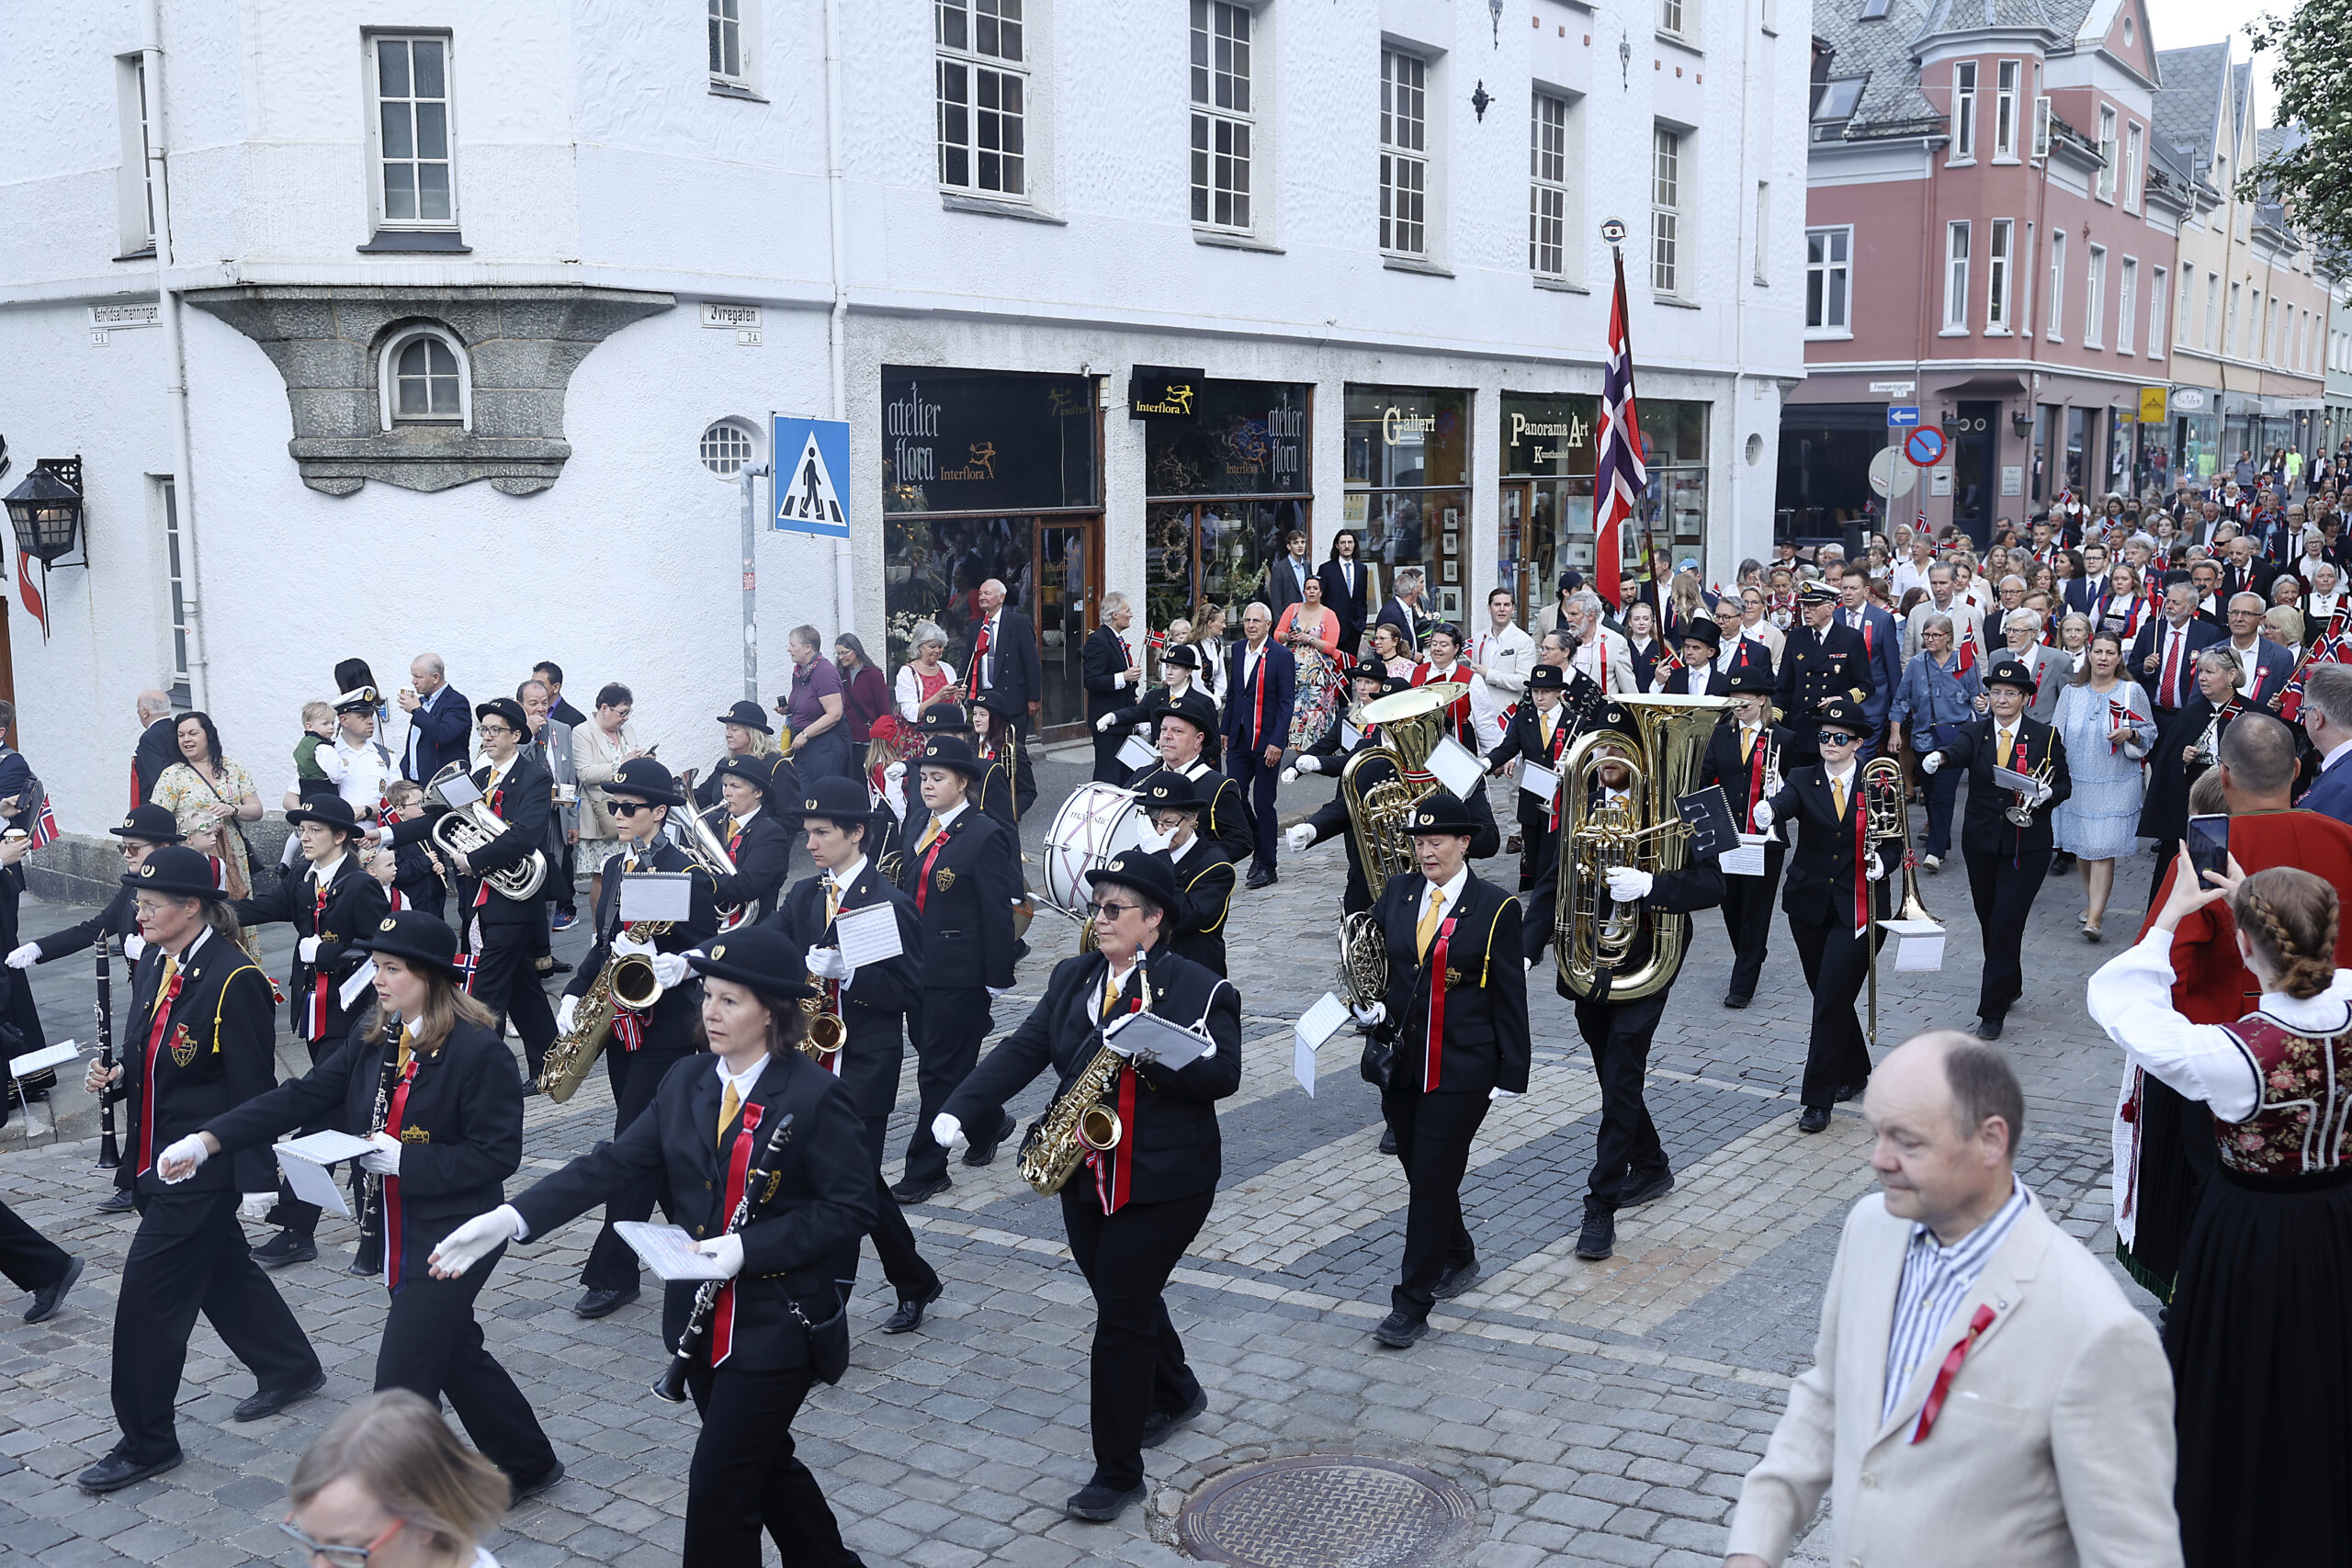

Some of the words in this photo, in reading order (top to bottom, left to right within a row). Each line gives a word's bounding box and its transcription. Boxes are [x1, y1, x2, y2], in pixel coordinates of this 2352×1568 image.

[711, 305, 755, 324] Øvregaten
[888, 383, 941, 437] atelier
[1136, 400, 1181, 414] Interflora
[1268, 396, 1303, 437] atelier
[1383, 407, 1435, 446] Galleri
[1510, 412, 1568, 446] Panorama
[1567, 415, 1589, 447] Art
[895, 438, 935, 494] flora
[1226, 462, 1259, 474] Interflora
[1272, 438, 1297, 484] flora
[1533, 446, 1569, 464] Kunsthandel
[940, 466, 985, 480] Interflora
